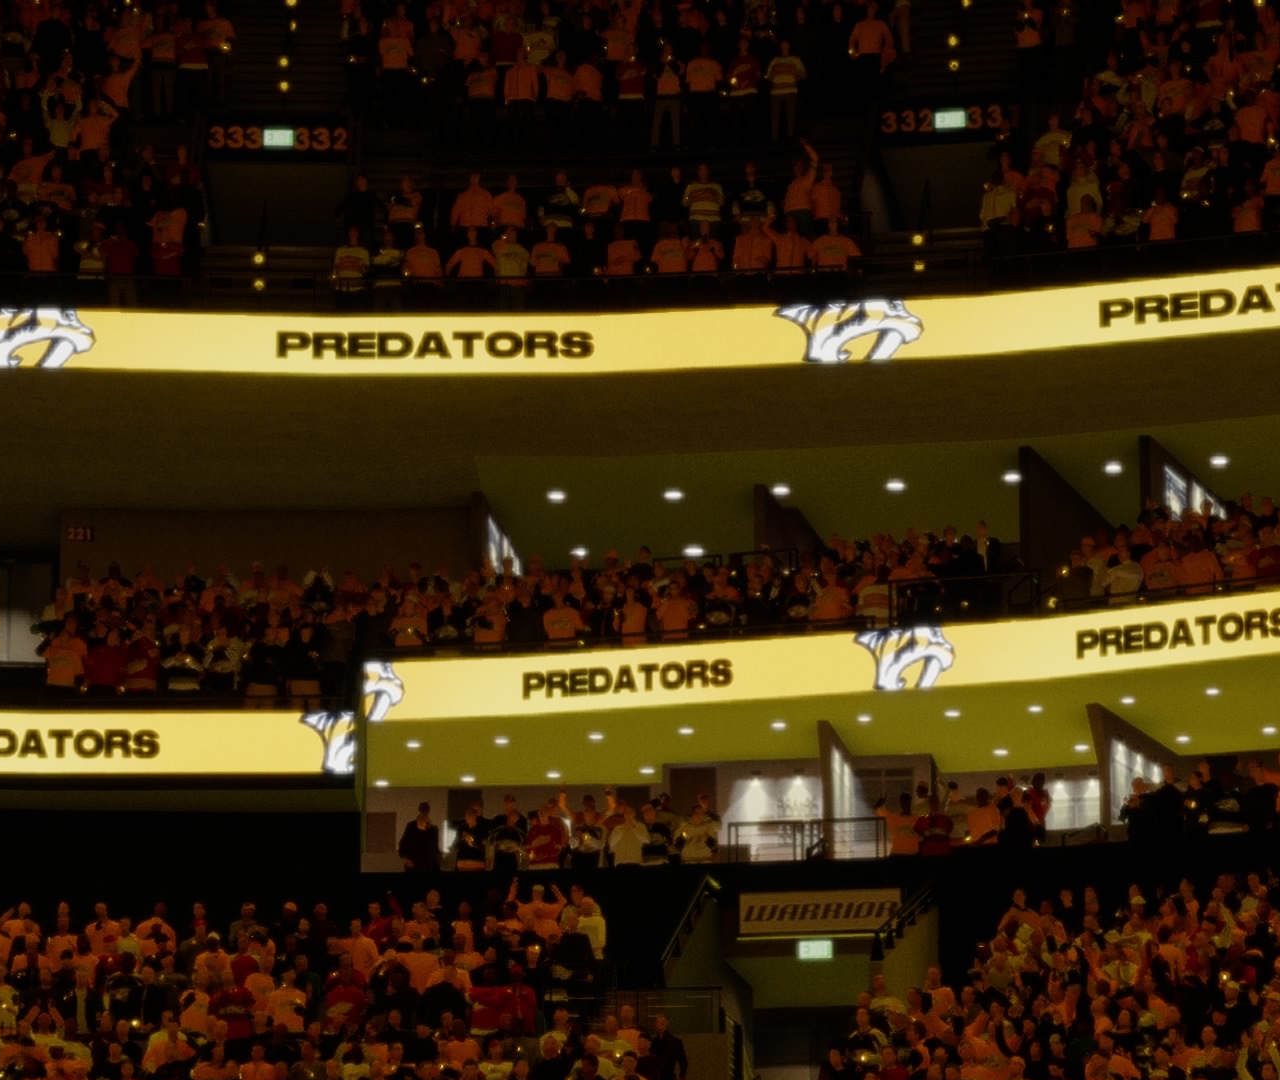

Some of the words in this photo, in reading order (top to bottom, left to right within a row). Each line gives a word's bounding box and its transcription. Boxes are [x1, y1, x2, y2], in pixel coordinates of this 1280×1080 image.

[880, 107, 934, 135] 332
[208, 125, 262, 150] 333
[293, 126, 349, 151] 332
[276, 330, 595, 360] PREDATORS
[522, 658, 734, 701] PREDATORS
[743, 900, 898, 922] WARRIOR
